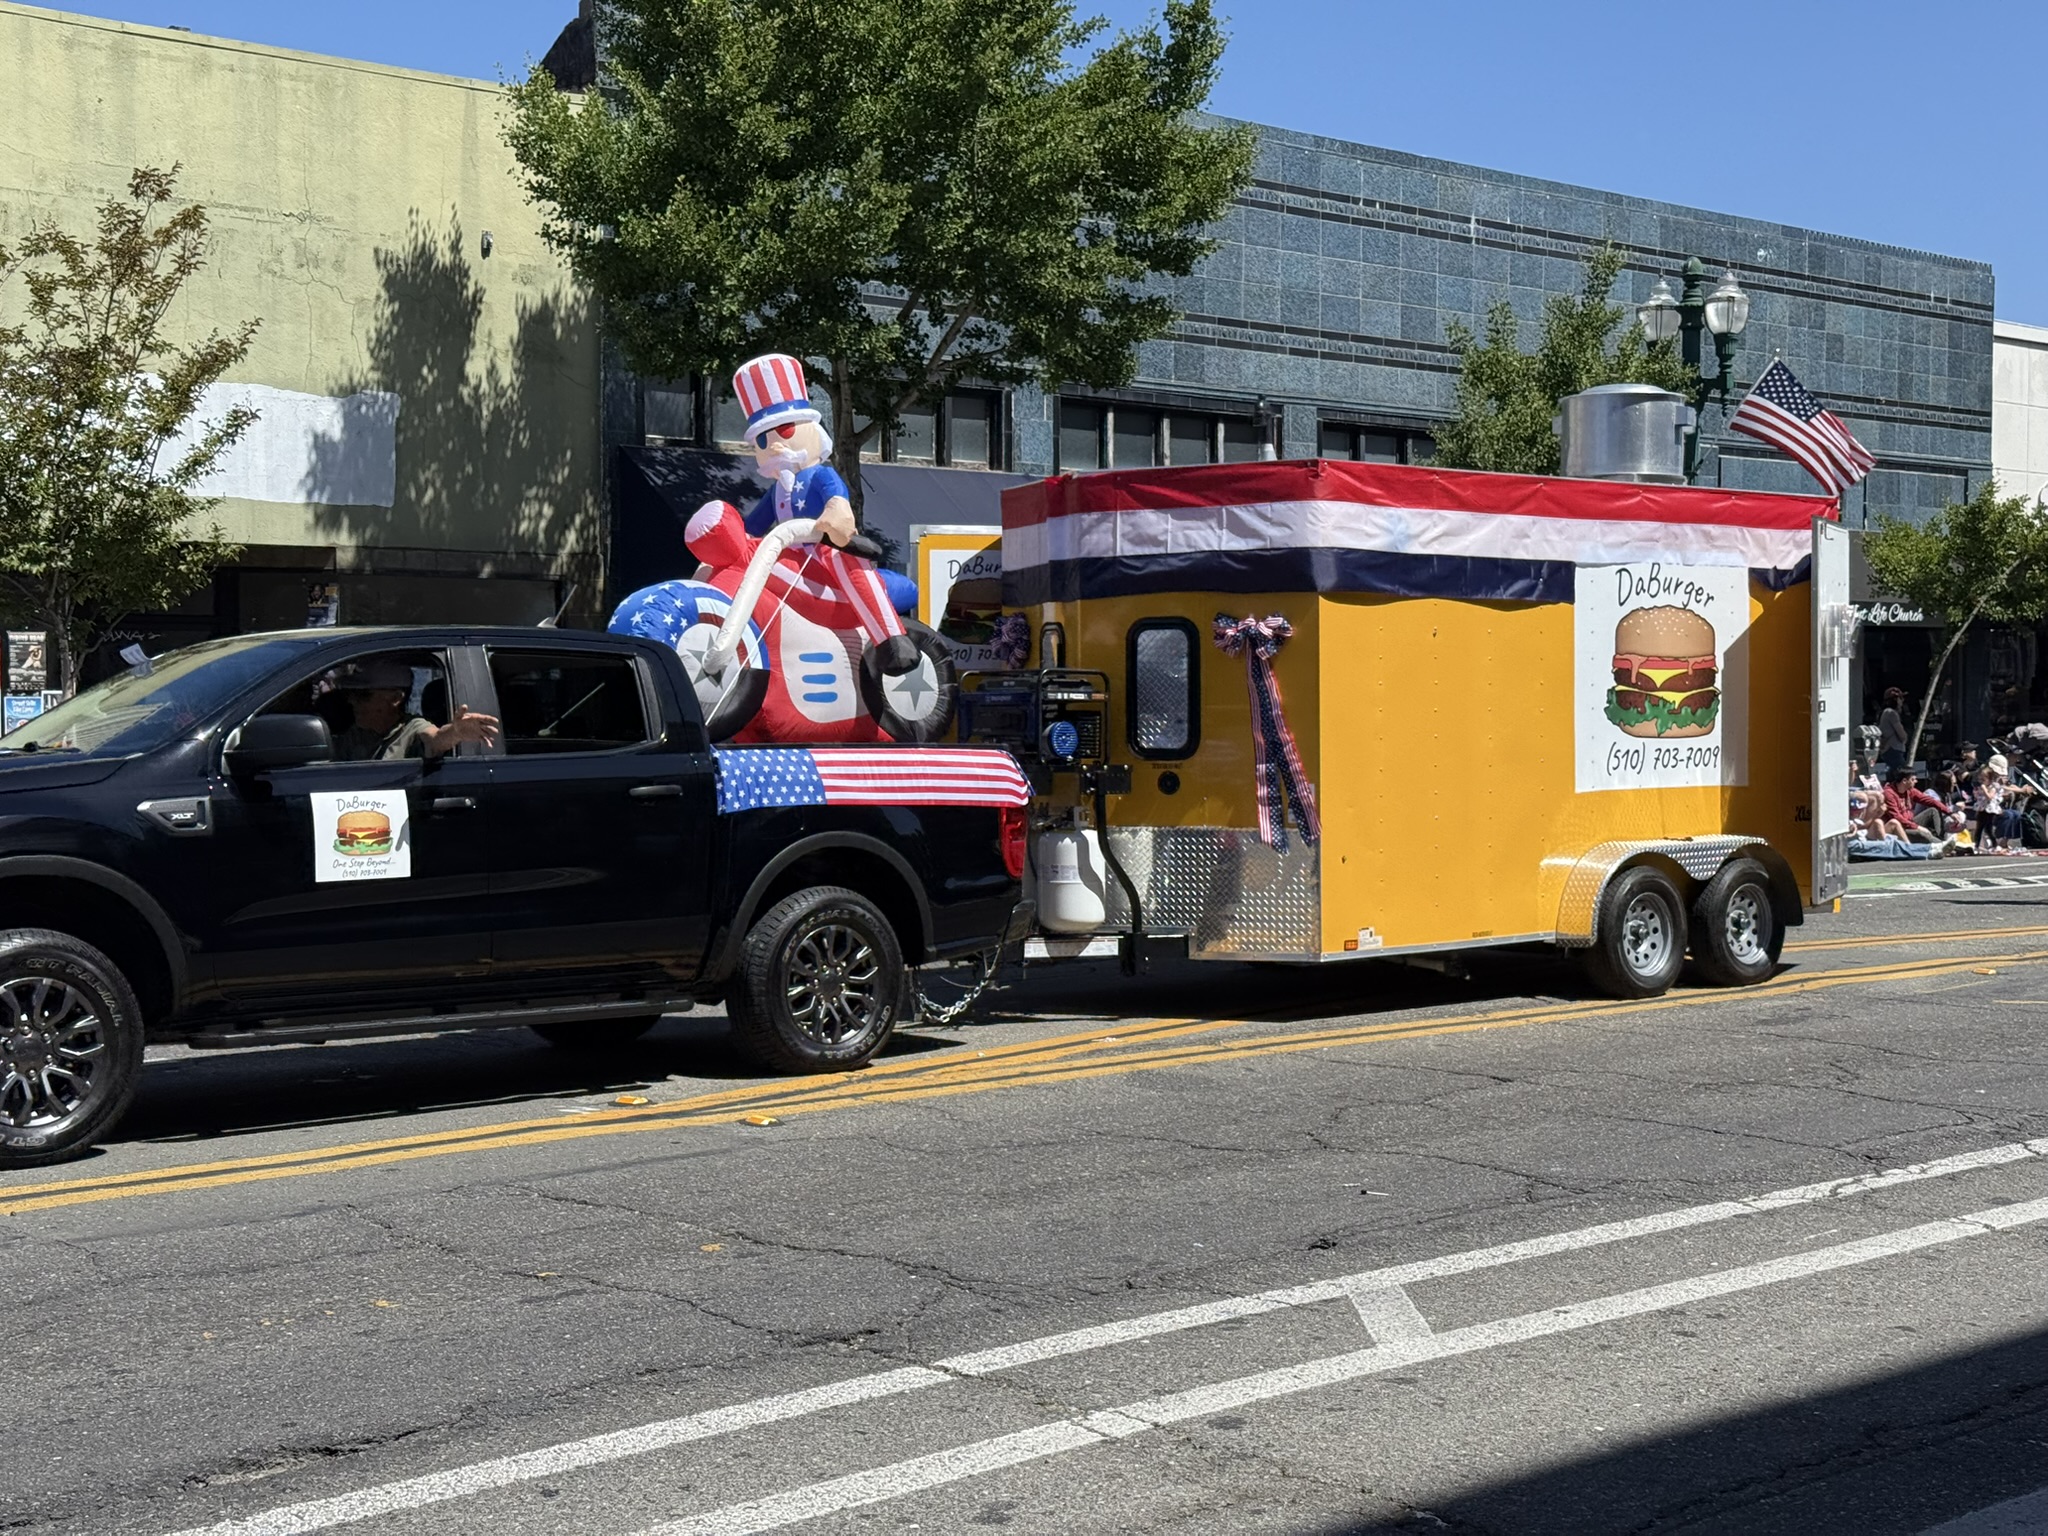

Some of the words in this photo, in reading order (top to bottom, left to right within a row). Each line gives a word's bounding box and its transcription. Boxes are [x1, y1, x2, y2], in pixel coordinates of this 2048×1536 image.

[947, 556, 1002, 579] DaBur
[1615, 562, 1715, 609] DaBurger
[1888, 603, 1924, 623] Church
[1607, 741, 1645, 776] (510)
[1653, 745, 1720, 770] 703-7009
[336, 796, 387, 811] DaBurger
[170, 812, 195, 820] XLT
[332, 859, 347, 868] One
[348, 857, 365, 869] Step
